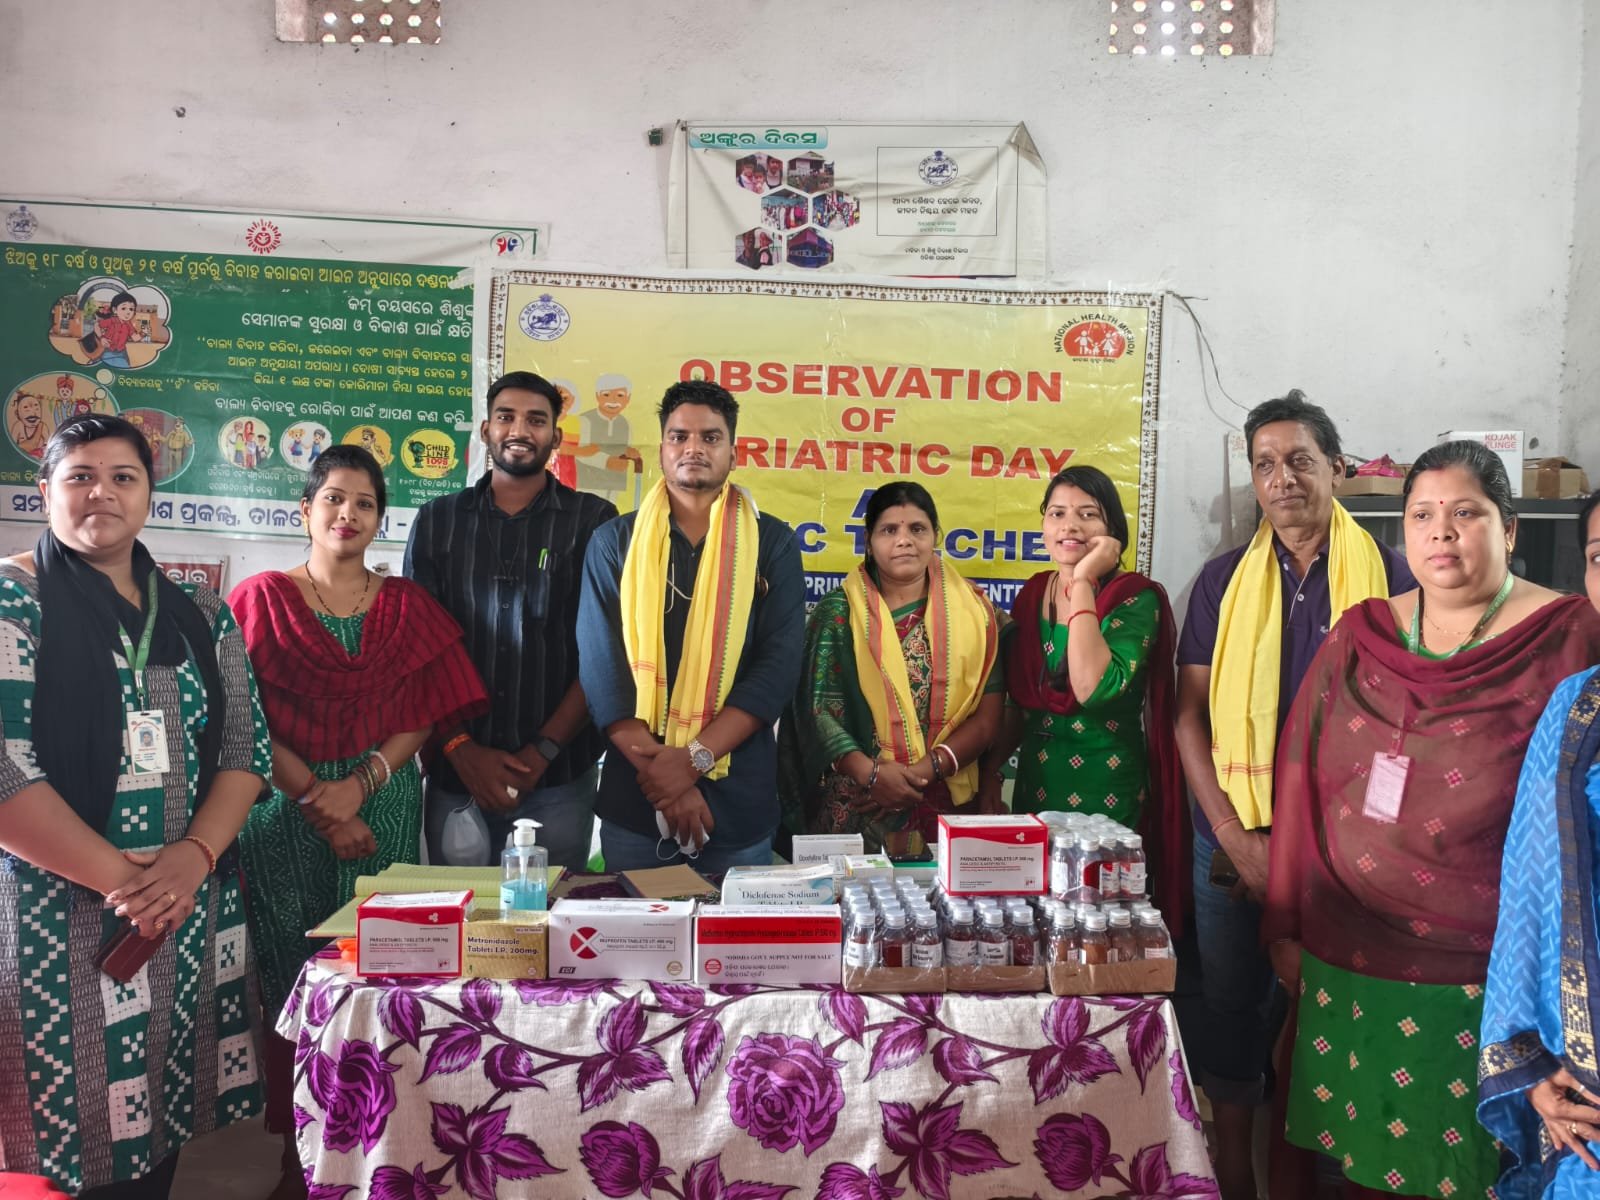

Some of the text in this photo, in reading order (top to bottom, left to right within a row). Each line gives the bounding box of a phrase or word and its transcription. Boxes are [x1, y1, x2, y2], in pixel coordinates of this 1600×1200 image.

[700, 128, 818, 147] ଅଙ୍କୁର ଦିବସ
[5, 246, 37, 270] ଝିଅକୁ
[64, 249, 88, 268] ବର୍ଷ
[89, 251, 98, 269] ଓ
[102, 255, 134, 275] ପୁଅକୁ
[139, 257, 156, 272] ୨୧
[162, 254, 186, 274] ବର୍ଷ
[187, 255, 223, 280] ପୂର୍ବରୁ
[225, 260, 260, 279] ବିବାହ
[264, 265, 314, 282] କରାଇବା
[319, 268, 354, 284] ଆଇନ
[358, 270, 411, 290] ଅନୁସାରେ
[377, 299, 435, 317] ବୟସରେ
[241, 312, 302, 329] ସେମାନଙ୍କ
[308, 315, 347, 335] ସୁରକ୍ଷା
[353, 318, 362, 332] ଓ
[369, 316, 408, 334] ବିକାଶ
[414, 316, 442, 337] ପାଇଁ
[1054, 318, 1080, 353] NATIONAL
[1081, 313, 1119, 324] HEALTH
[237, 337, 266, 352] ବିବାହ
[269, 340, 304, 356] କରିବା,
[382, 348, 407, 360] ବାଲ୍ୟ
[412, 348, 457, 363] ବିବାହରେ
[305, 360, 342, 373] ଅପରାଧ
[352, 362, 383, 375] ଦୋଷୀ
[424, 367, 454, 379] ହେଲେ
[679, 358, 1063, 403] OBSERVATION
[215, 396, 246, 410] ବାଲ୍ୟ
[251, 397, 296, 417] ବିବାହକୁ
[300, 399, 345, 417] ରୋକିବା
[350, 401, 376, 418] ପାଇଁ
[379, 406, 412, 421] ଆପଣ
[417, 408, 438, 422] କଣ
[840, 407, 897, 433] OF
[1484, 433, 1517, 441] KOJAK
[736, 436, 1074, 480] RIATRIC DAY
[742, 889, 820, 899] Diclofenac Sodium
[467, 936, 520, 945] Metronidazole
[467, 945, 493, 953] Tablets
